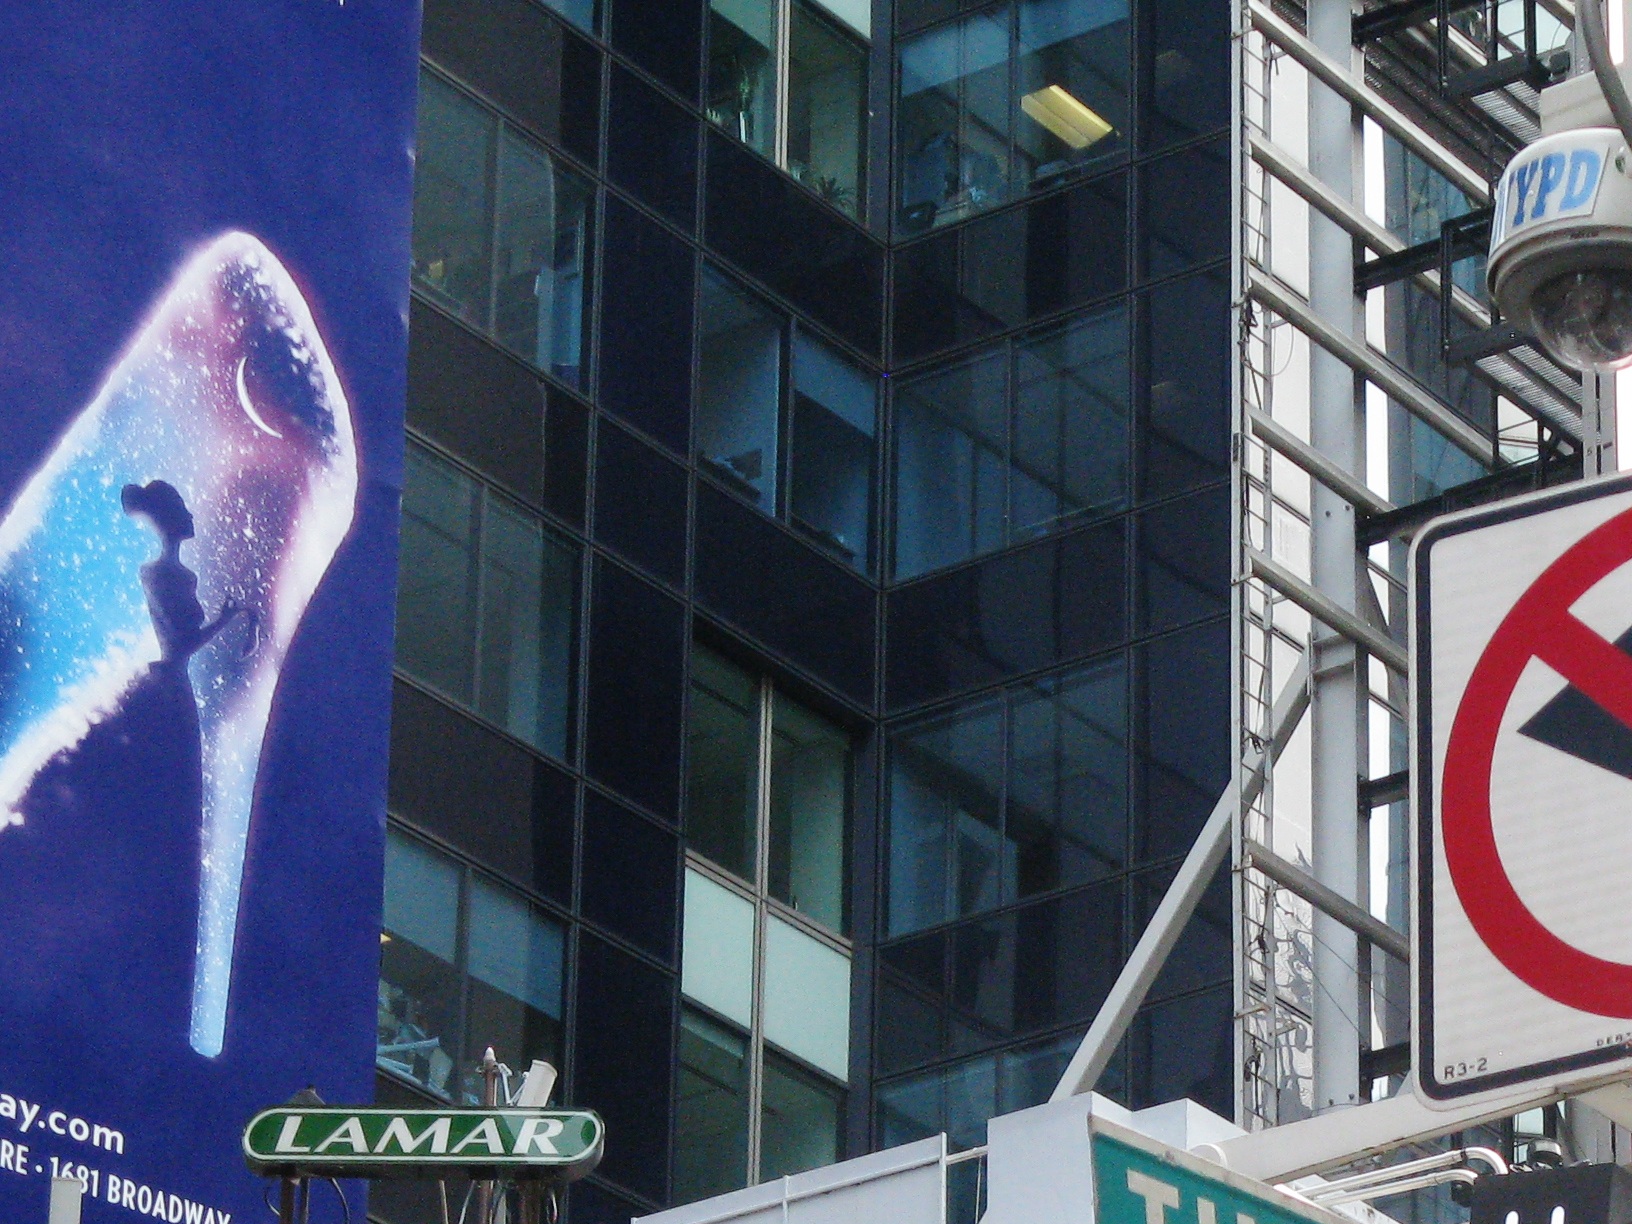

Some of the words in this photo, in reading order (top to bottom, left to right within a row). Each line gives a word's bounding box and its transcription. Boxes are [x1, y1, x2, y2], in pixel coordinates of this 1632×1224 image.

[1509, 147, 1602, 228] YPD
[1443, 1057, 1489, 1081] R3-2
[274, 1115, 564, 1156] LAMAR
